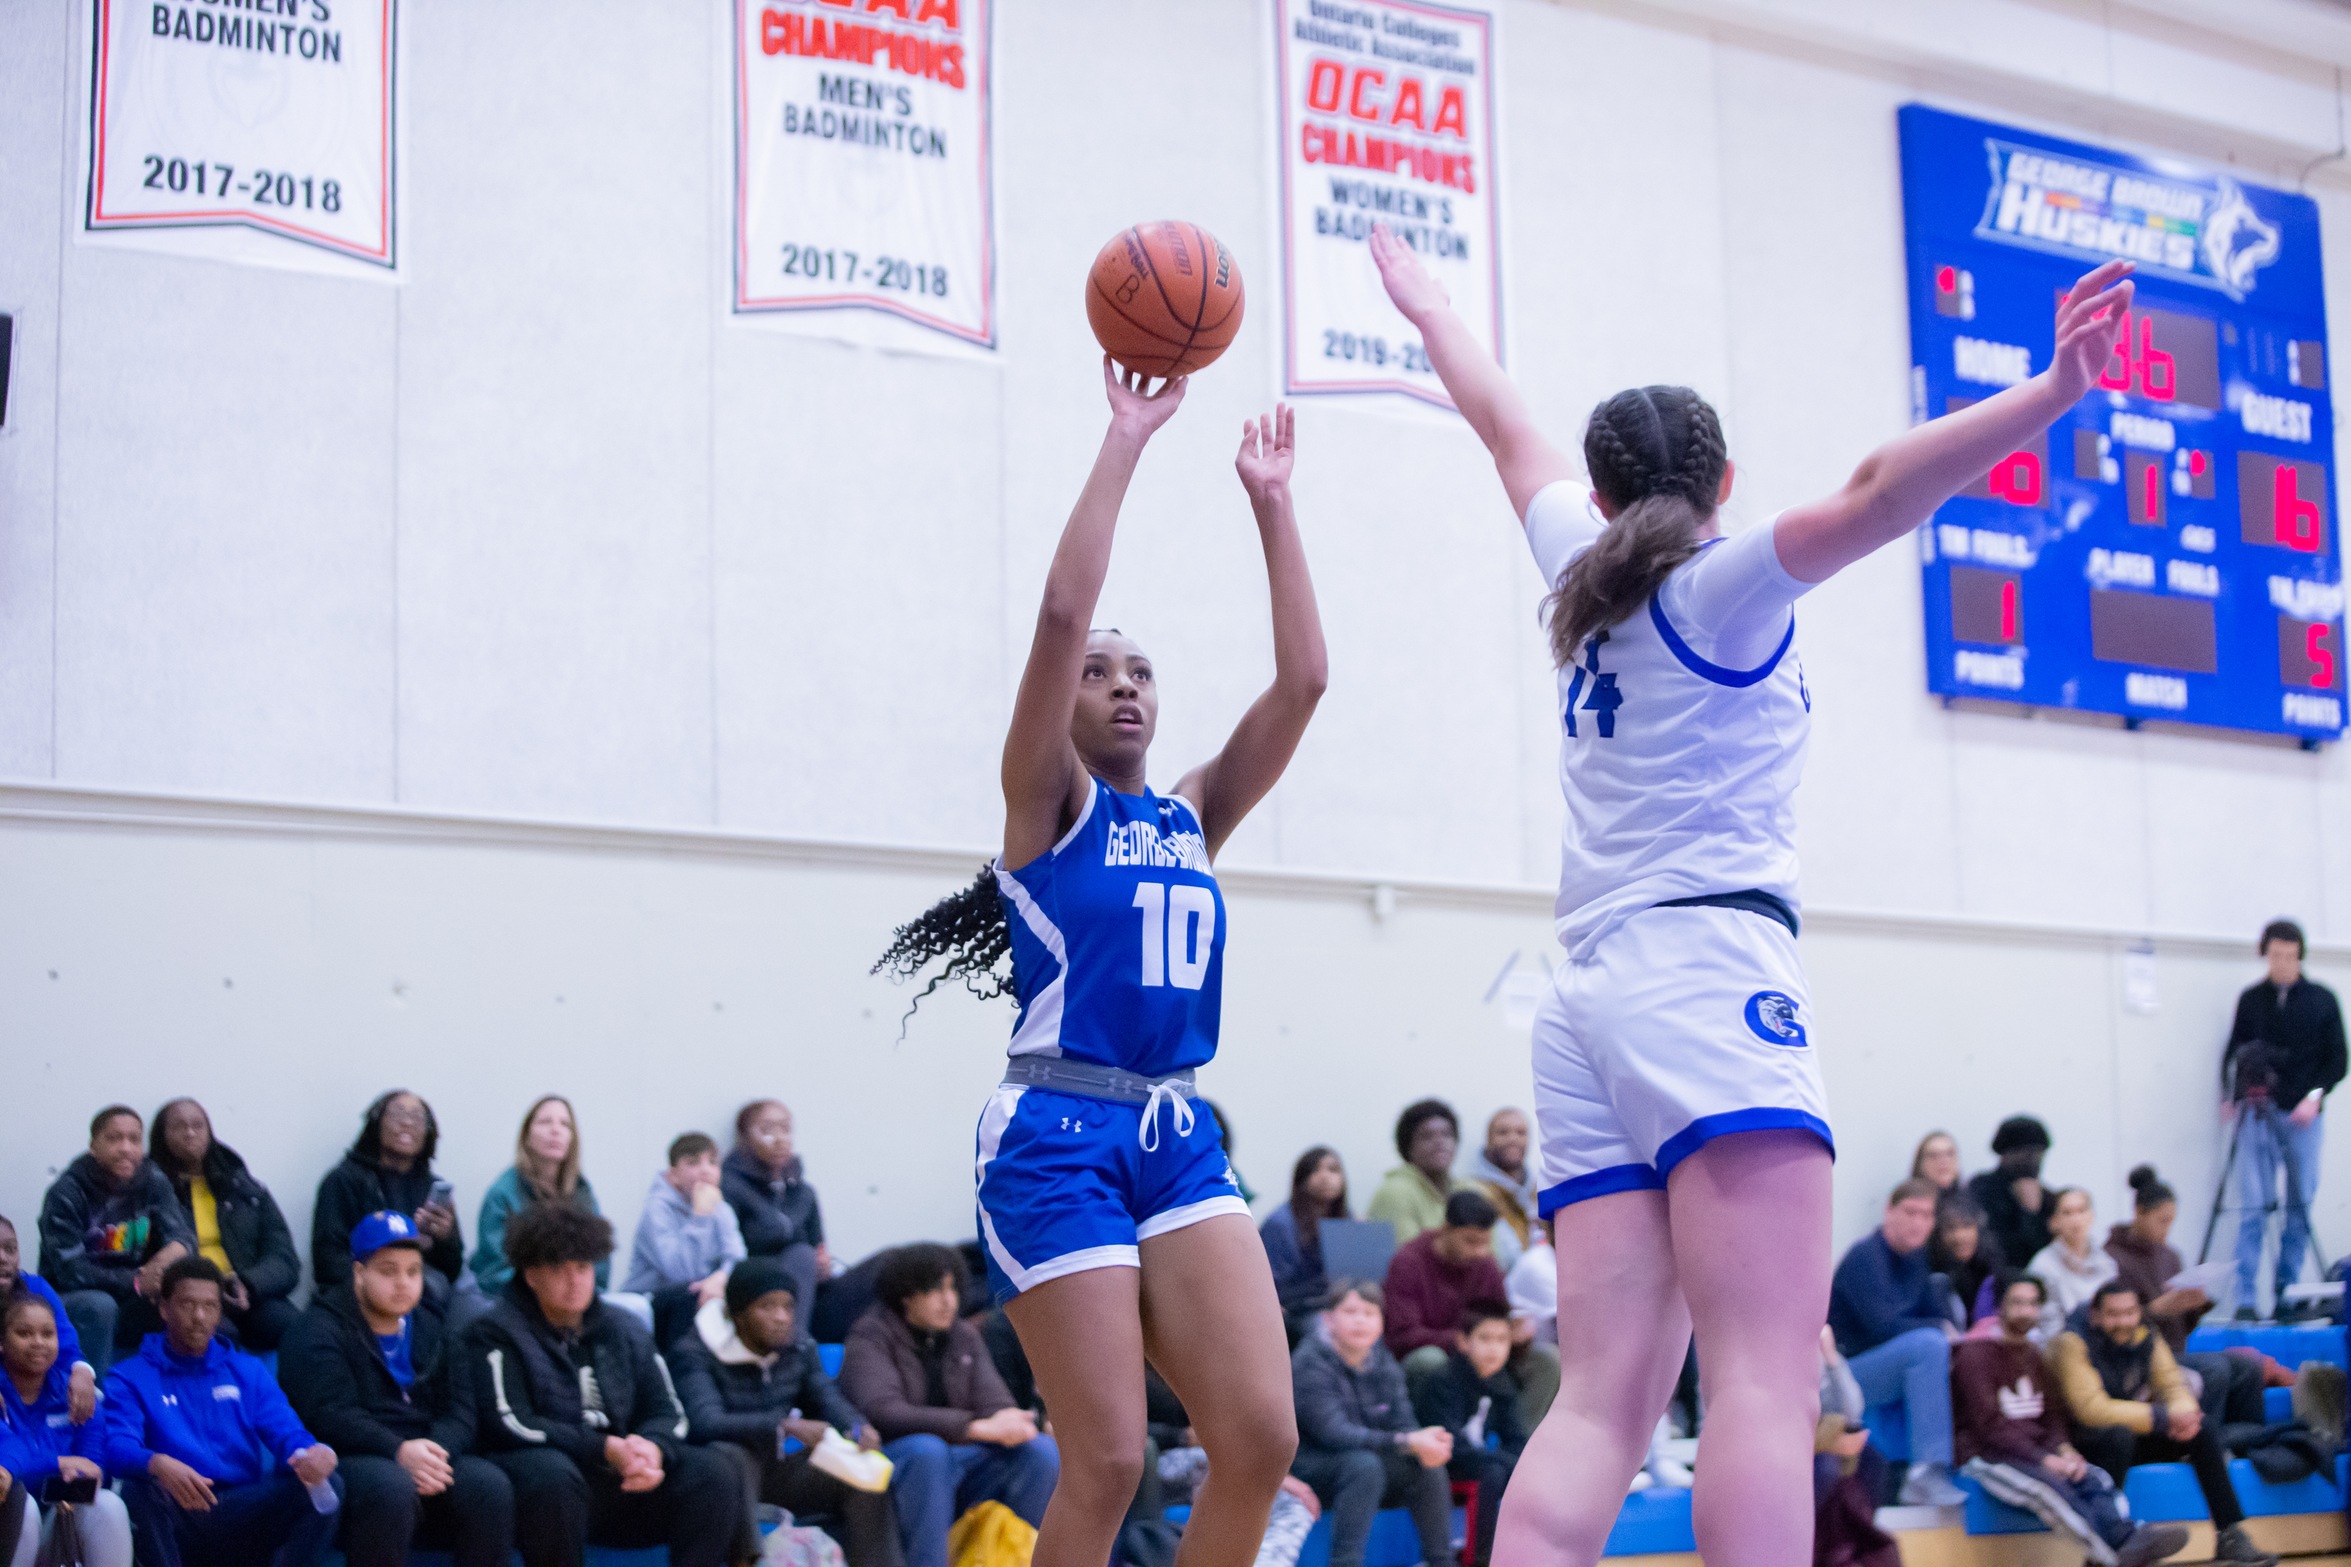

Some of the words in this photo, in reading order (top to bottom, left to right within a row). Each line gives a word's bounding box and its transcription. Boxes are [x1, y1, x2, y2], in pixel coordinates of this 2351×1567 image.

[152, 4, 341, 63] BADMINTON
[761, 8, 965, 90] CHAMPIONS
[819, 72, 911, 117] MEN'S
[1307, 60, 1467, 139] OCAA
[784, 102, 946, 158] BADMINTON
[1302, 122, 1477, 195] CHAMPIONS
[144, 155, 342, 213] 2017-2018
[1315, 206, 1469, 260] BADNTON
[782, 243, 949, 297] 2017-2018
[1132, 881, 1216, 991] 10
